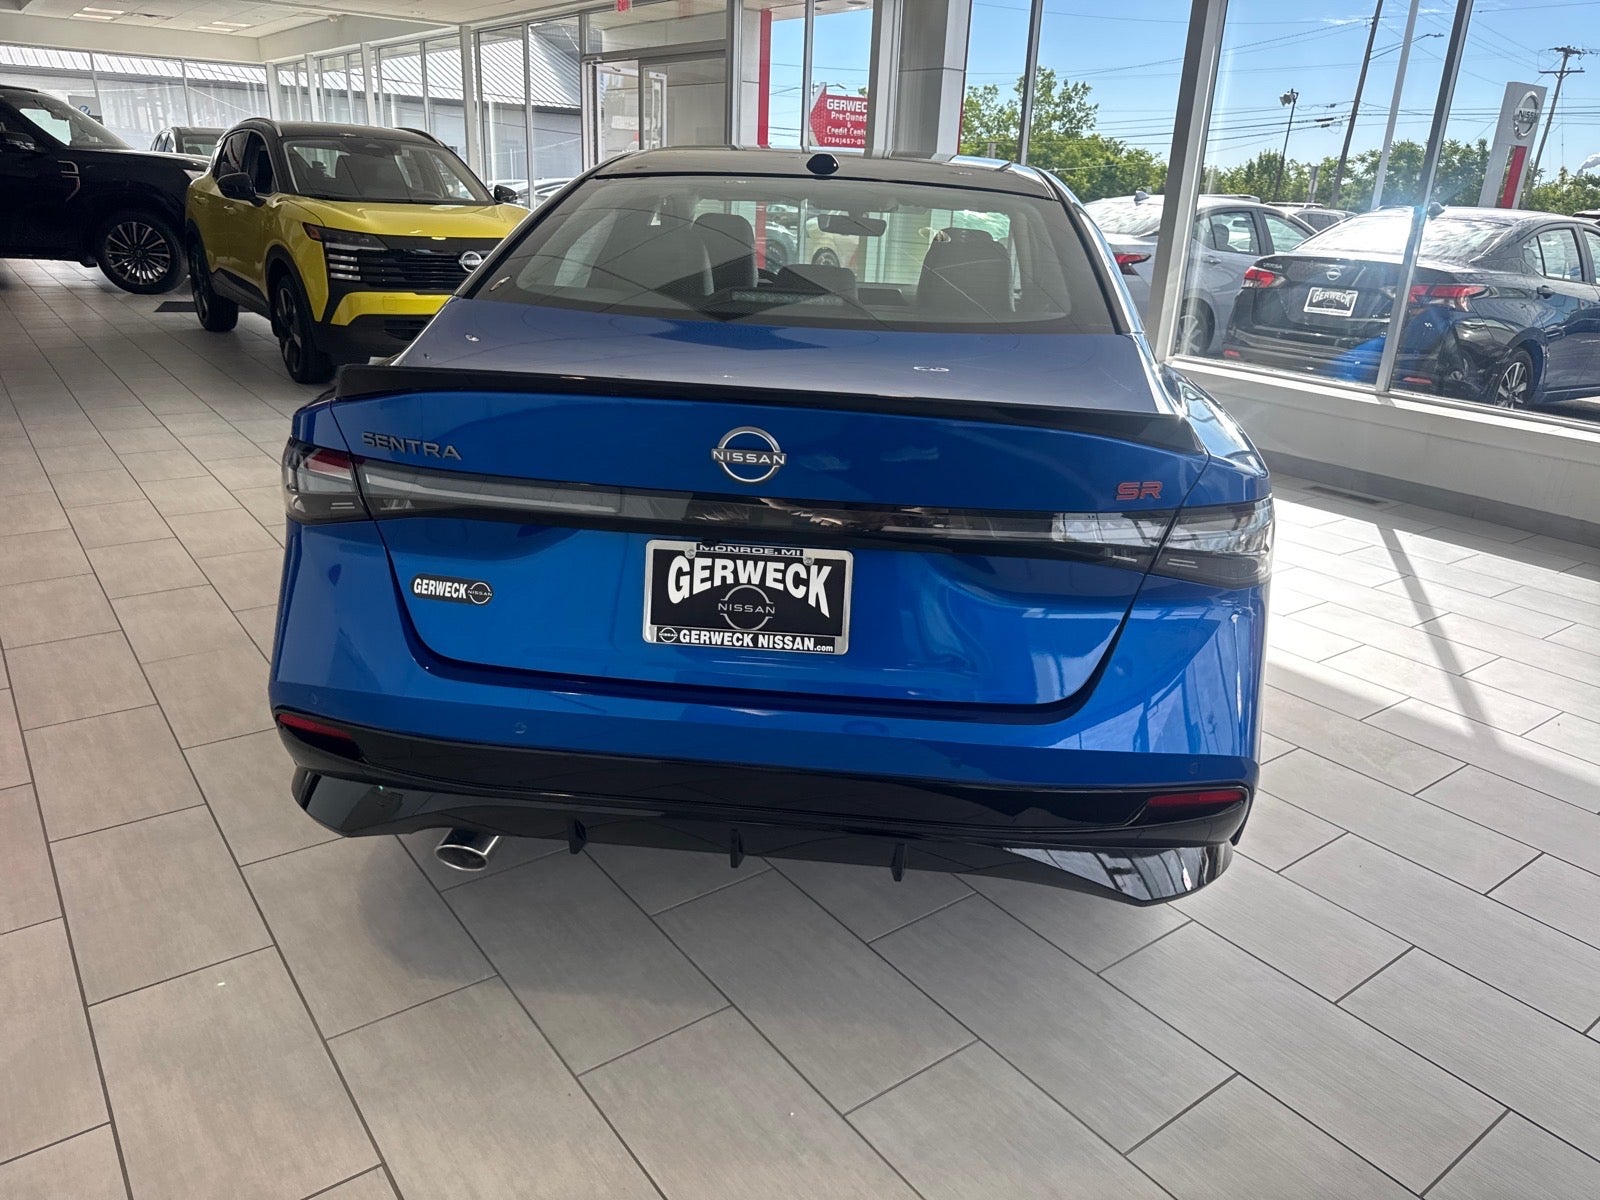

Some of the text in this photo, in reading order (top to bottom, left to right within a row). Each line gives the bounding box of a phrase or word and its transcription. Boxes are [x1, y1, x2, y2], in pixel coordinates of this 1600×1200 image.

[827, 99, 868, 112] GERWEC
[831, 111, 867, 122] Pre-Owned
[826, 126, 848, 136] Credit
[1312, 290, 1356, 308] GERWECK
[361, 430, 462, 461] SENTRA
[712, 451, 785, 465] NISSAN
[1115, 480, 1163, 501] SR
[781, 549, 801, 557] MI
[413, 577, 493, 600] GERWECK NISSAN
[667, 554, 833, 619] GERWECK
[717, 602, 776, 615] NISSAN
[679, 629, 754, 649] GERWECK
[757, 633, 834, 653] NISSAN.com
